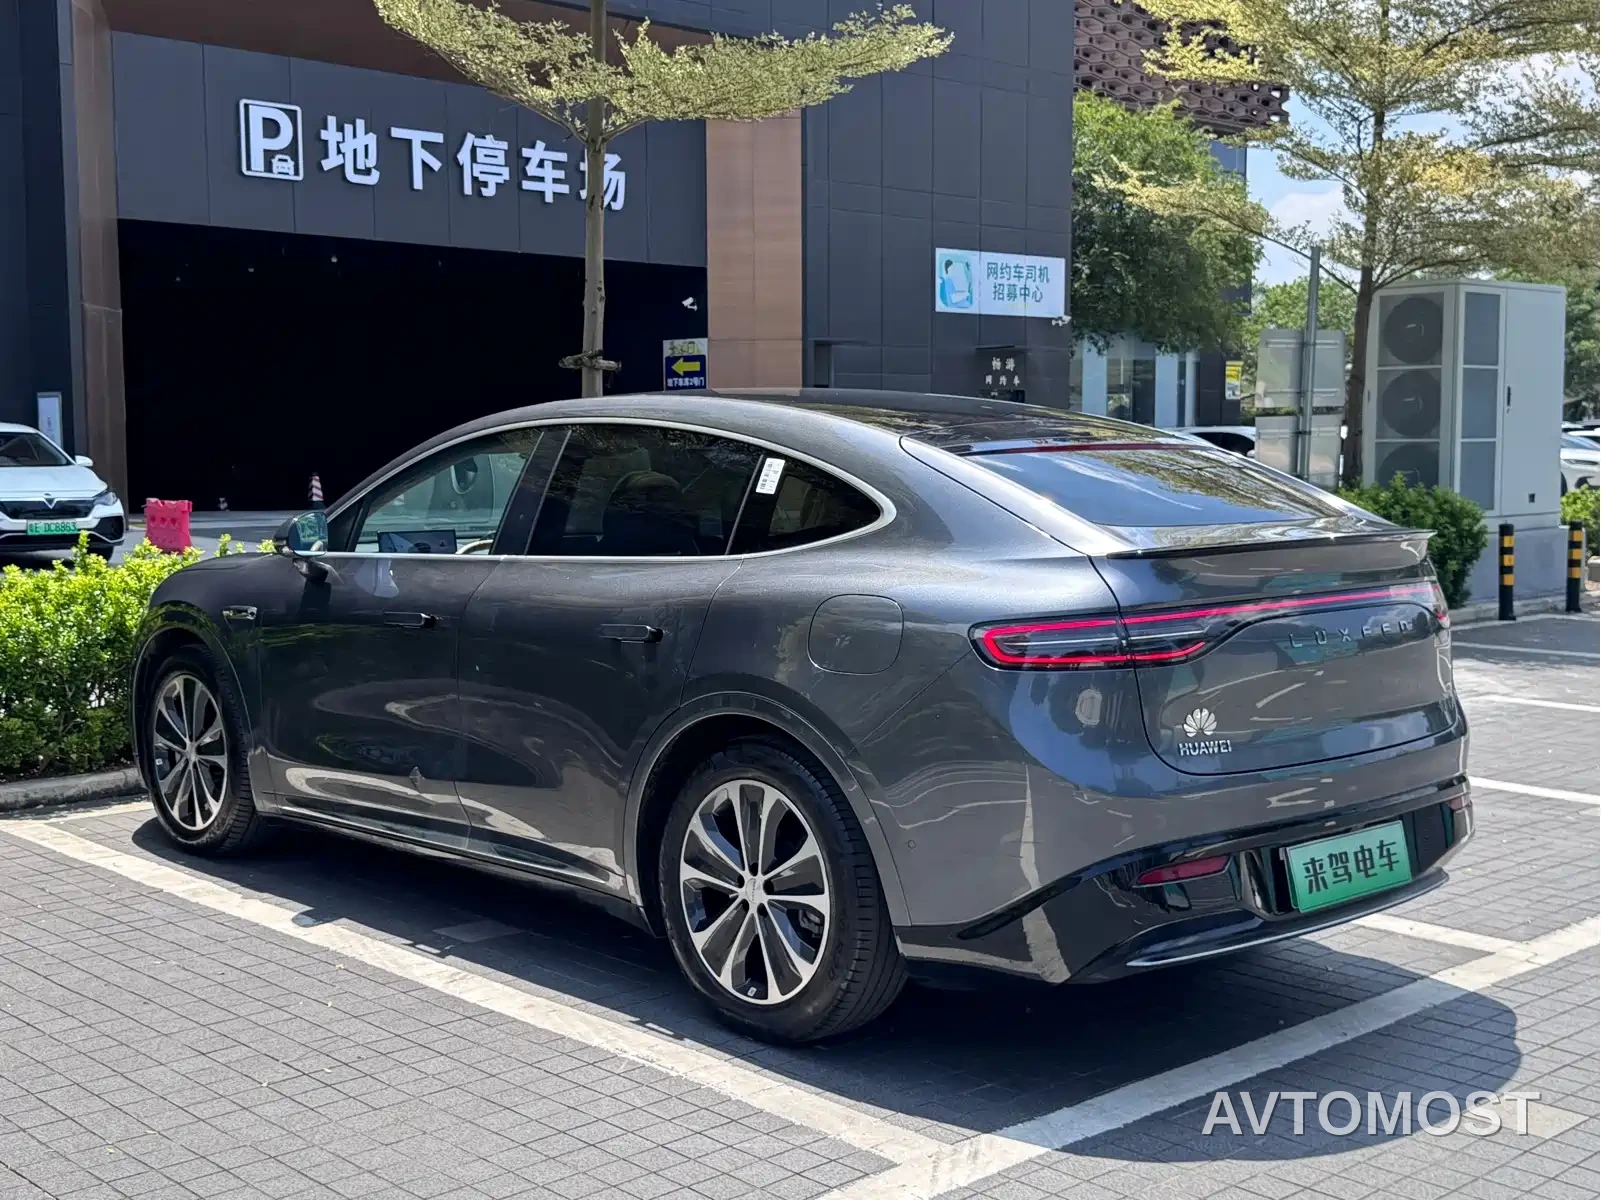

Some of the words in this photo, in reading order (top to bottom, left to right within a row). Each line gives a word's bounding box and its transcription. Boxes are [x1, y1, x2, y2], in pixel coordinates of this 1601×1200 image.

[319, 114, 627, 211] 地下停车场
[986, 262, 1050, 284] 网约车司机
[993, 282, 1044, 303] 招募中心
[1178, 739, 1232, 756] HUAWEI
[1302, 839, 1400, 895] 来驾电车
